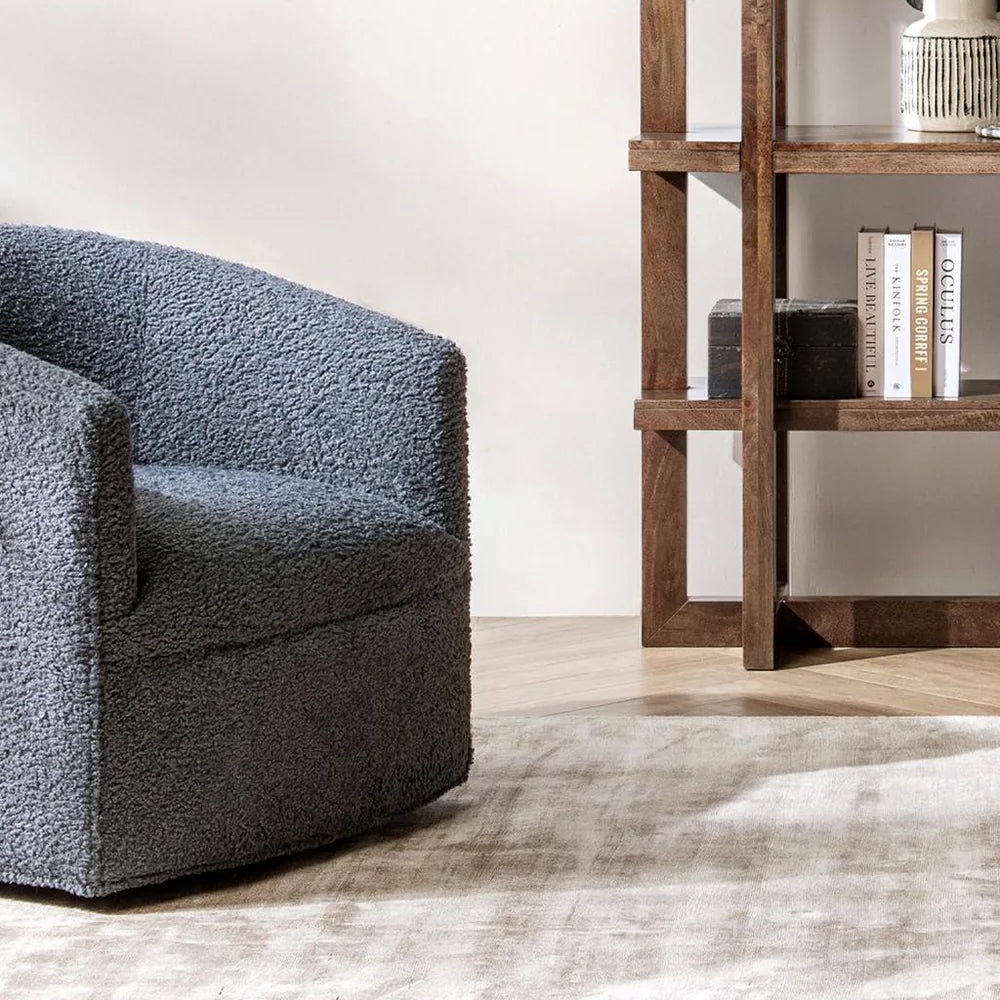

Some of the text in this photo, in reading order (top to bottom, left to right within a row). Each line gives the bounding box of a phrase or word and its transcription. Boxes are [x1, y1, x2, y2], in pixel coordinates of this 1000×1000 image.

[865, 258, 876, 290] LIVE
[915, 269, 929, 313] SPRING
[939, 258, 955, 345] OCULUS
[892, 276, 901, 333] KINFOLK
[865, 294, 876, 373] BEAUTIFUL
